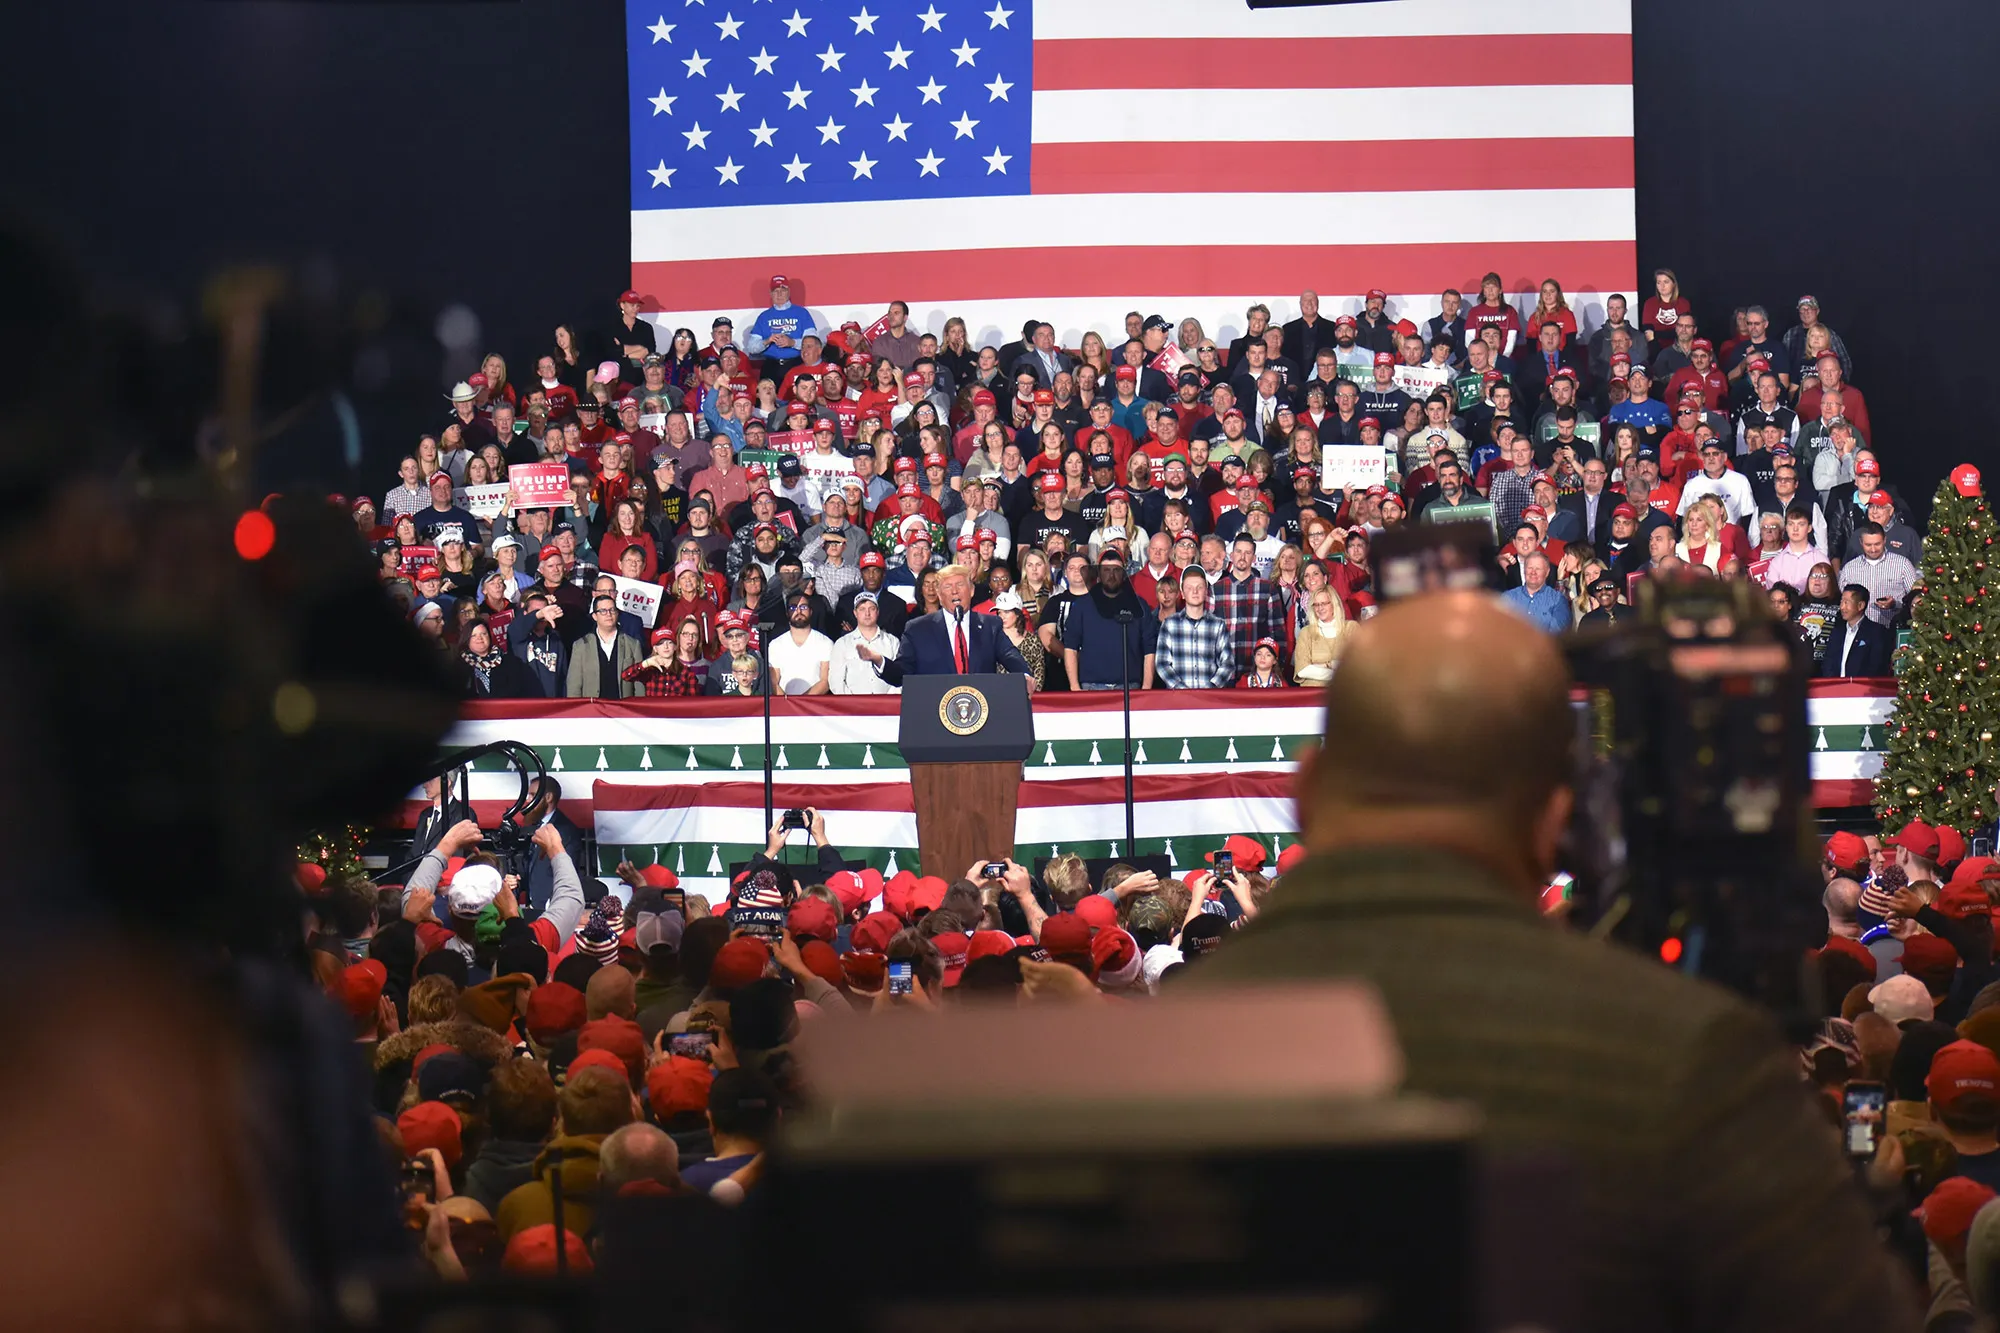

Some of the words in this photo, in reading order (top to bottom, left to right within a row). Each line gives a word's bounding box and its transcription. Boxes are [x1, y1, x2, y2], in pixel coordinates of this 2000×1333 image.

[768, 318, 798, 327] TRUMP
[782, 325, 797, 334] 2020
[1395, 377, 1443, 387] TRUMP
[773, 441, 814, 451] TRUM
[1811, 437, 1833, 448] SPART
[806, 469, 858, 477] TRUMP
[513, 475, 567, 485] TRUMP
[457, 493, 507, 503] TRUMP
[621, 591, 655, 605] UMP
[622, 601, 648, 611] NCE
[1801, 607, 1837, 616] HRISTMAS
[734, 911, 750, 922] EAT
[1191, 935, 1221, 946] Trump
